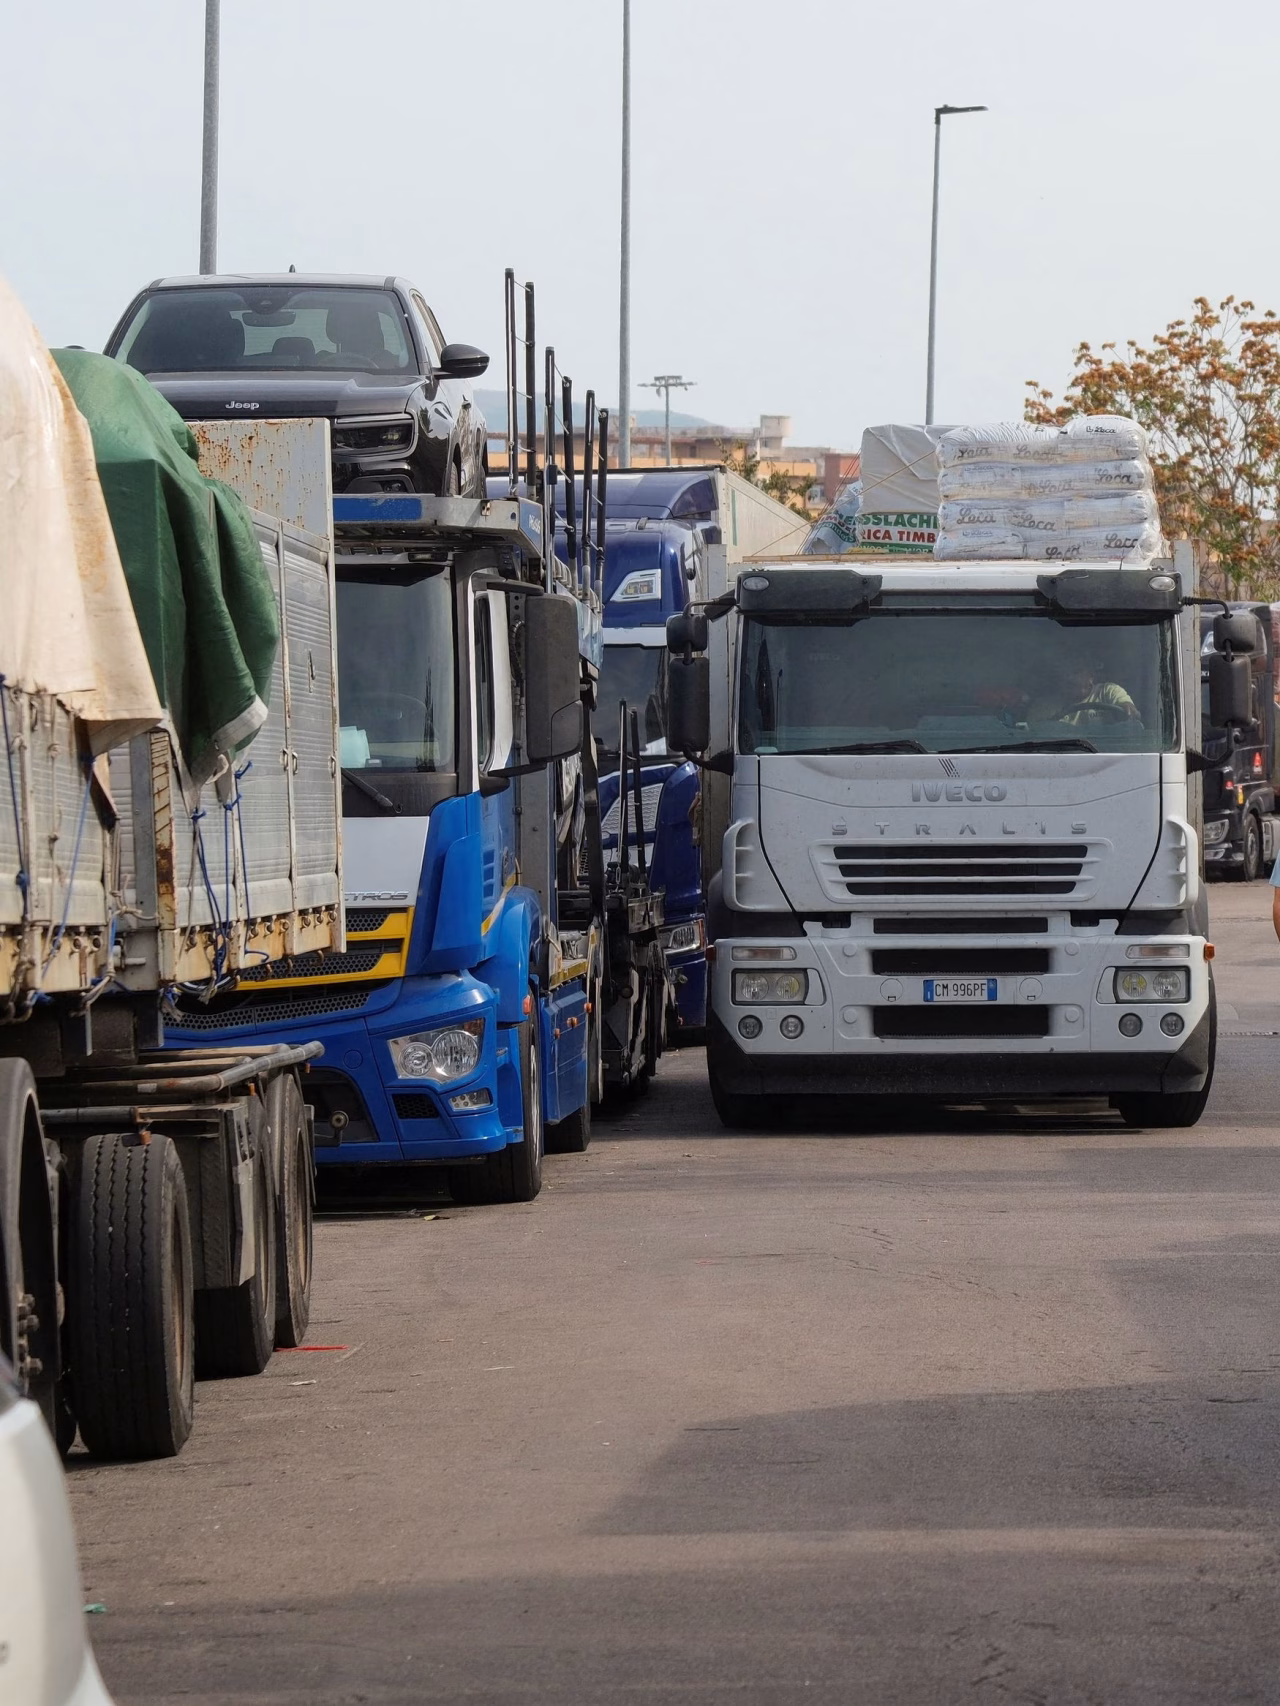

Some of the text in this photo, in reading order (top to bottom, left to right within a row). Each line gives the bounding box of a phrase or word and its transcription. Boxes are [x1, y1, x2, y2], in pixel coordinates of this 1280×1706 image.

[225, 401, 260, 410] Jeep
[957, 507, 997, 524] Leca
[911, 782, 1008, 802] IVECO
[831, 821, 1088, 836] STRALIS
[934, 983, 950, 997] CM
[952, 983, 987, 997] 996PF
